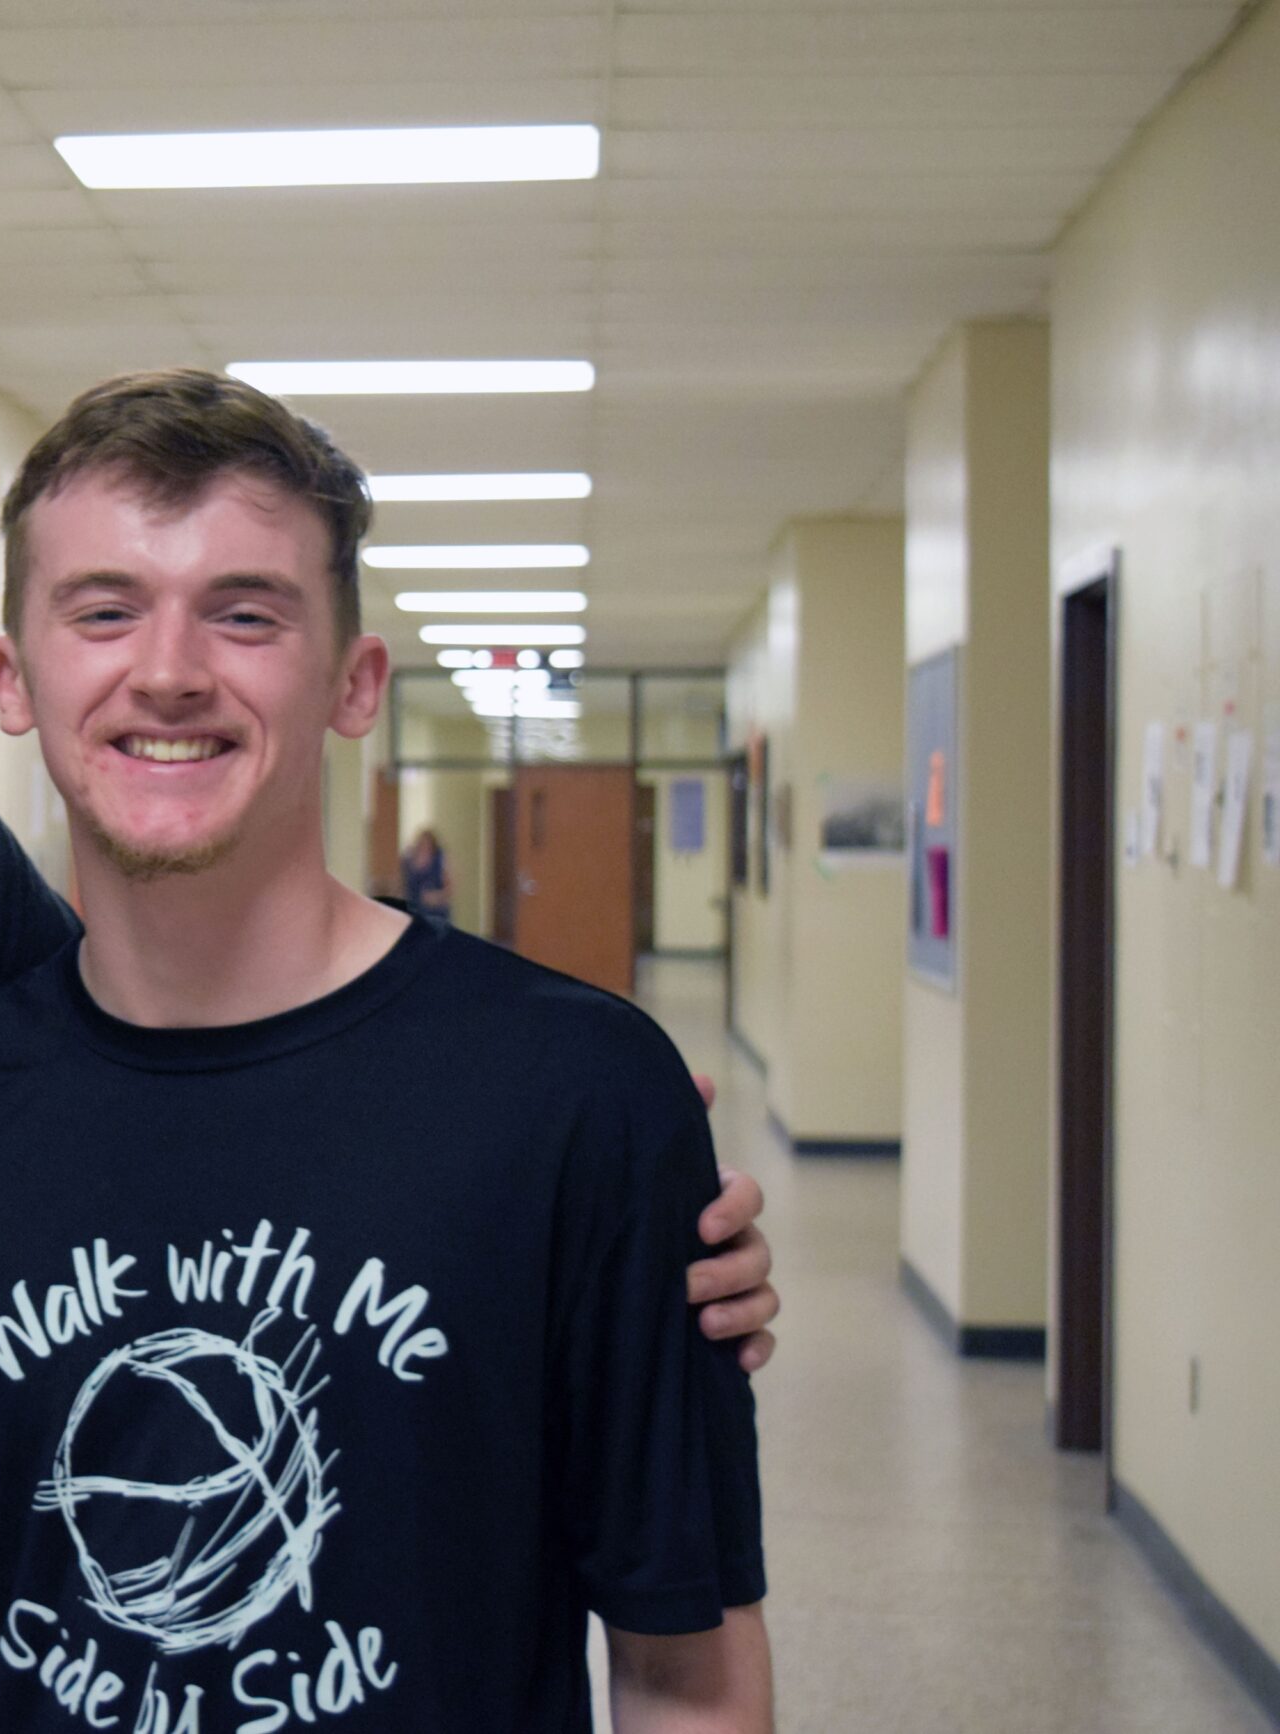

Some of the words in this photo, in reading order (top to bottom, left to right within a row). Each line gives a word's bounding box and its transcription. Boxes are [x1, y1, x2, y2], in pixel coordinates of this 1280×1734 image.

[168, 1219, 316, 1319] with
[333, 1257, 449, 1382] Me
[231, 1619, 397, 1734] Side
